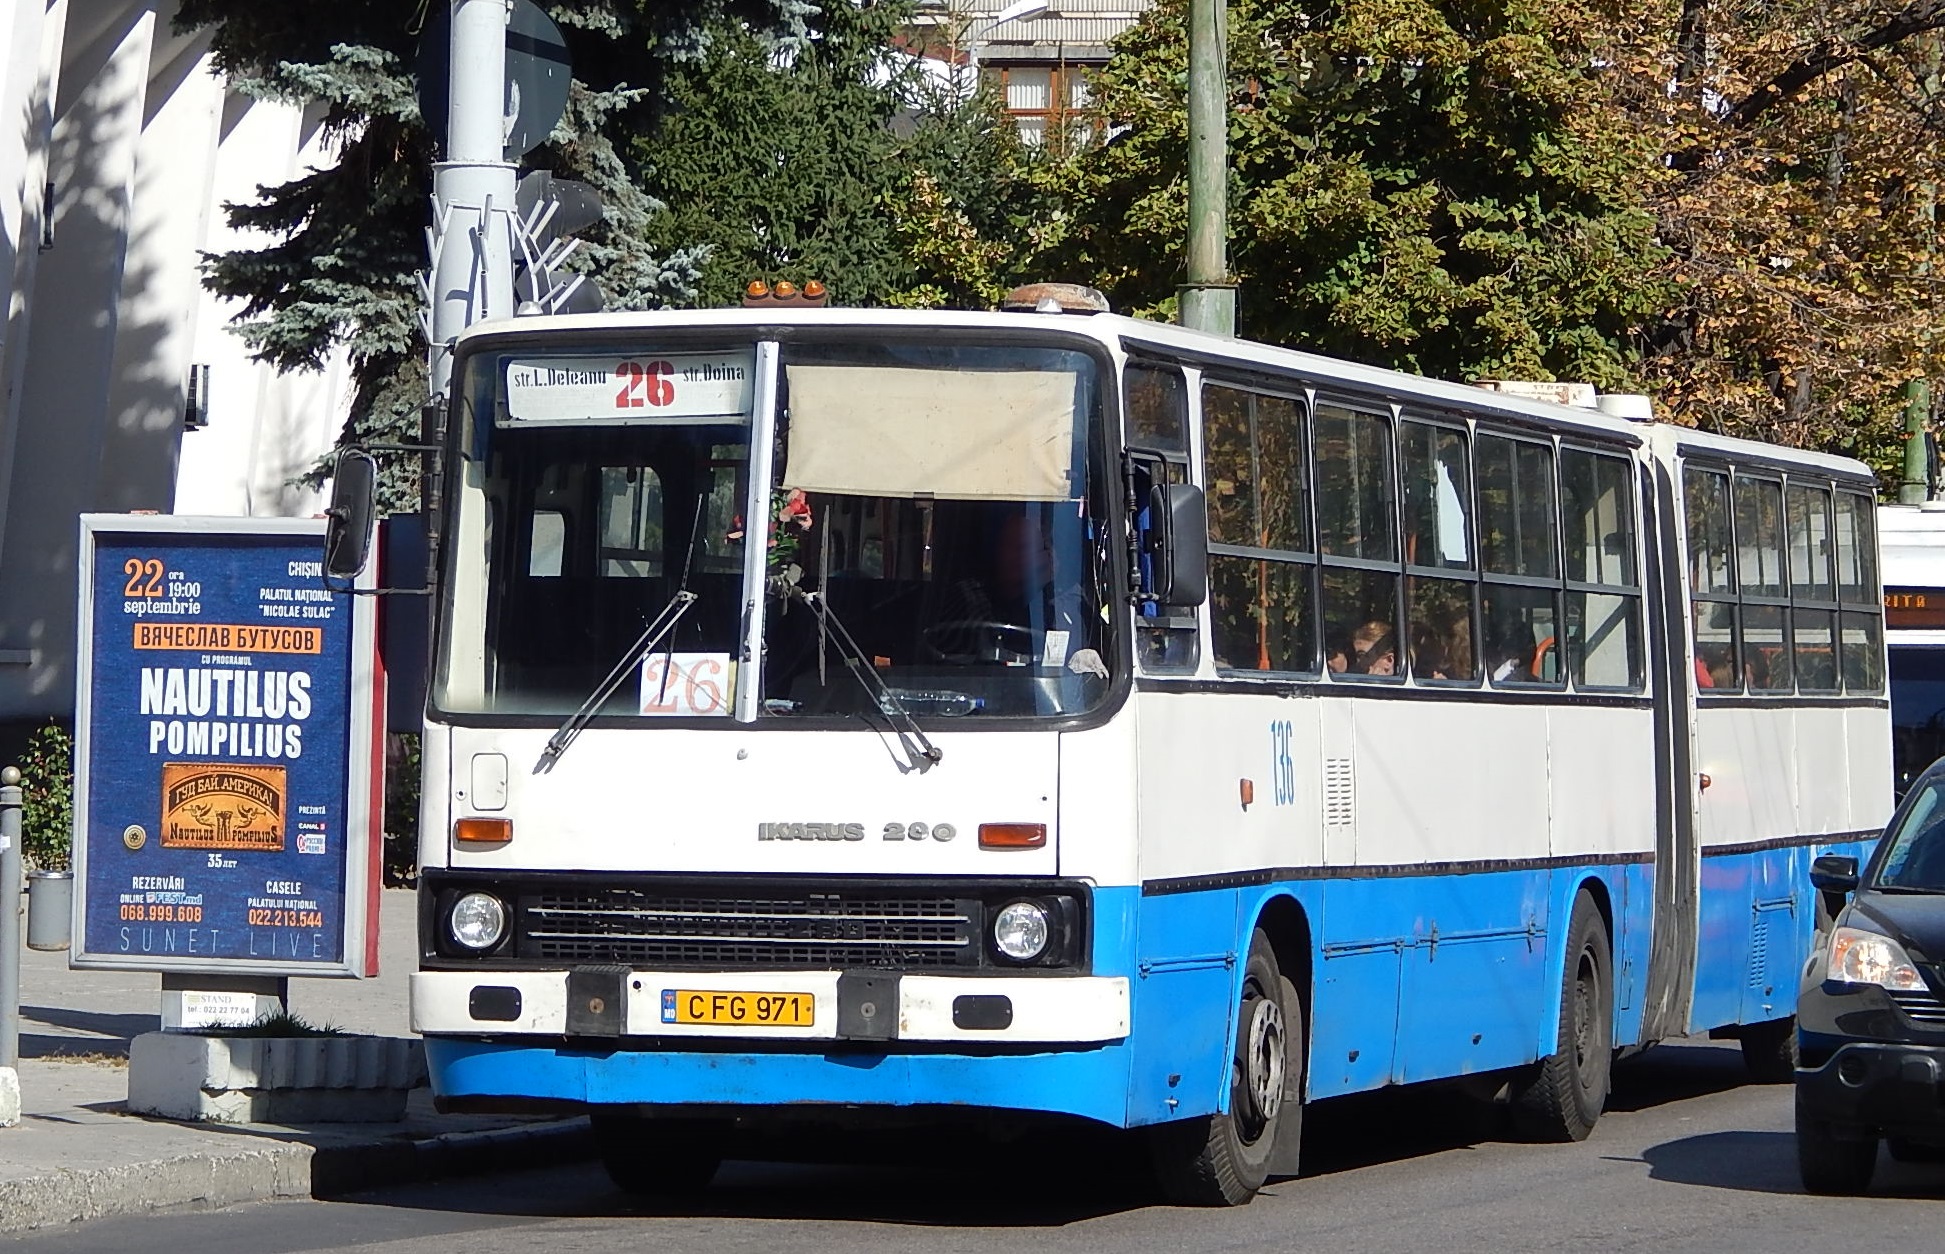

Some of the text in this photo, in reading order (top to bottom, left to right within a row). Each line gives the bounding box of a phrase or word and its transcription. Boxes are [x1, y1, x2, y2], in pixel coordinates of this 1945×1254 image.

[615, 360, 676, 408] 26
[124, 558, 164, 597] 22
[168, 571, 185, 580] ora
[288, 561, 323, 580] CHIȘIN
[168, 581, 201, 598] 19:00
[260, 588, 294, 601] PALATUL
[124, 596, 201, 618] septembrie
[140, 626, 314, 651] ВЯЧЕСЛАВ БУТУСОВ
[201, 654, 252, 666] CU PROGRAMUL
[140, 667, 312, 720] NAUTILUS
[643, 658, 721, 714] 26
[149, 720, 302, 759] POMPILIUS
[1270, 719, 1295, 807] 136
[175, 780, 196, 804] ГУД
[220, 777, 273, 808] АМЕРИКА!
[298, 822, 320, 830] CANAL
[757, 821, 958, 843] IKARUS 280
[207, 853, 223, 868] 35
[132, 875, 185, 891] REZERVĂRI
[265, 880, 302, 895] CASELE
[120, 893, 145, 904] ONLINE
[247, 897, 284, 908] PALATULUI
[120, 904, 202, 923] 068.999.608
[248, 908, 323, 928] 022.213.544
[120, 926, 322, 958] SUNET LIVE
[757, 996, 799, 1021] 971
